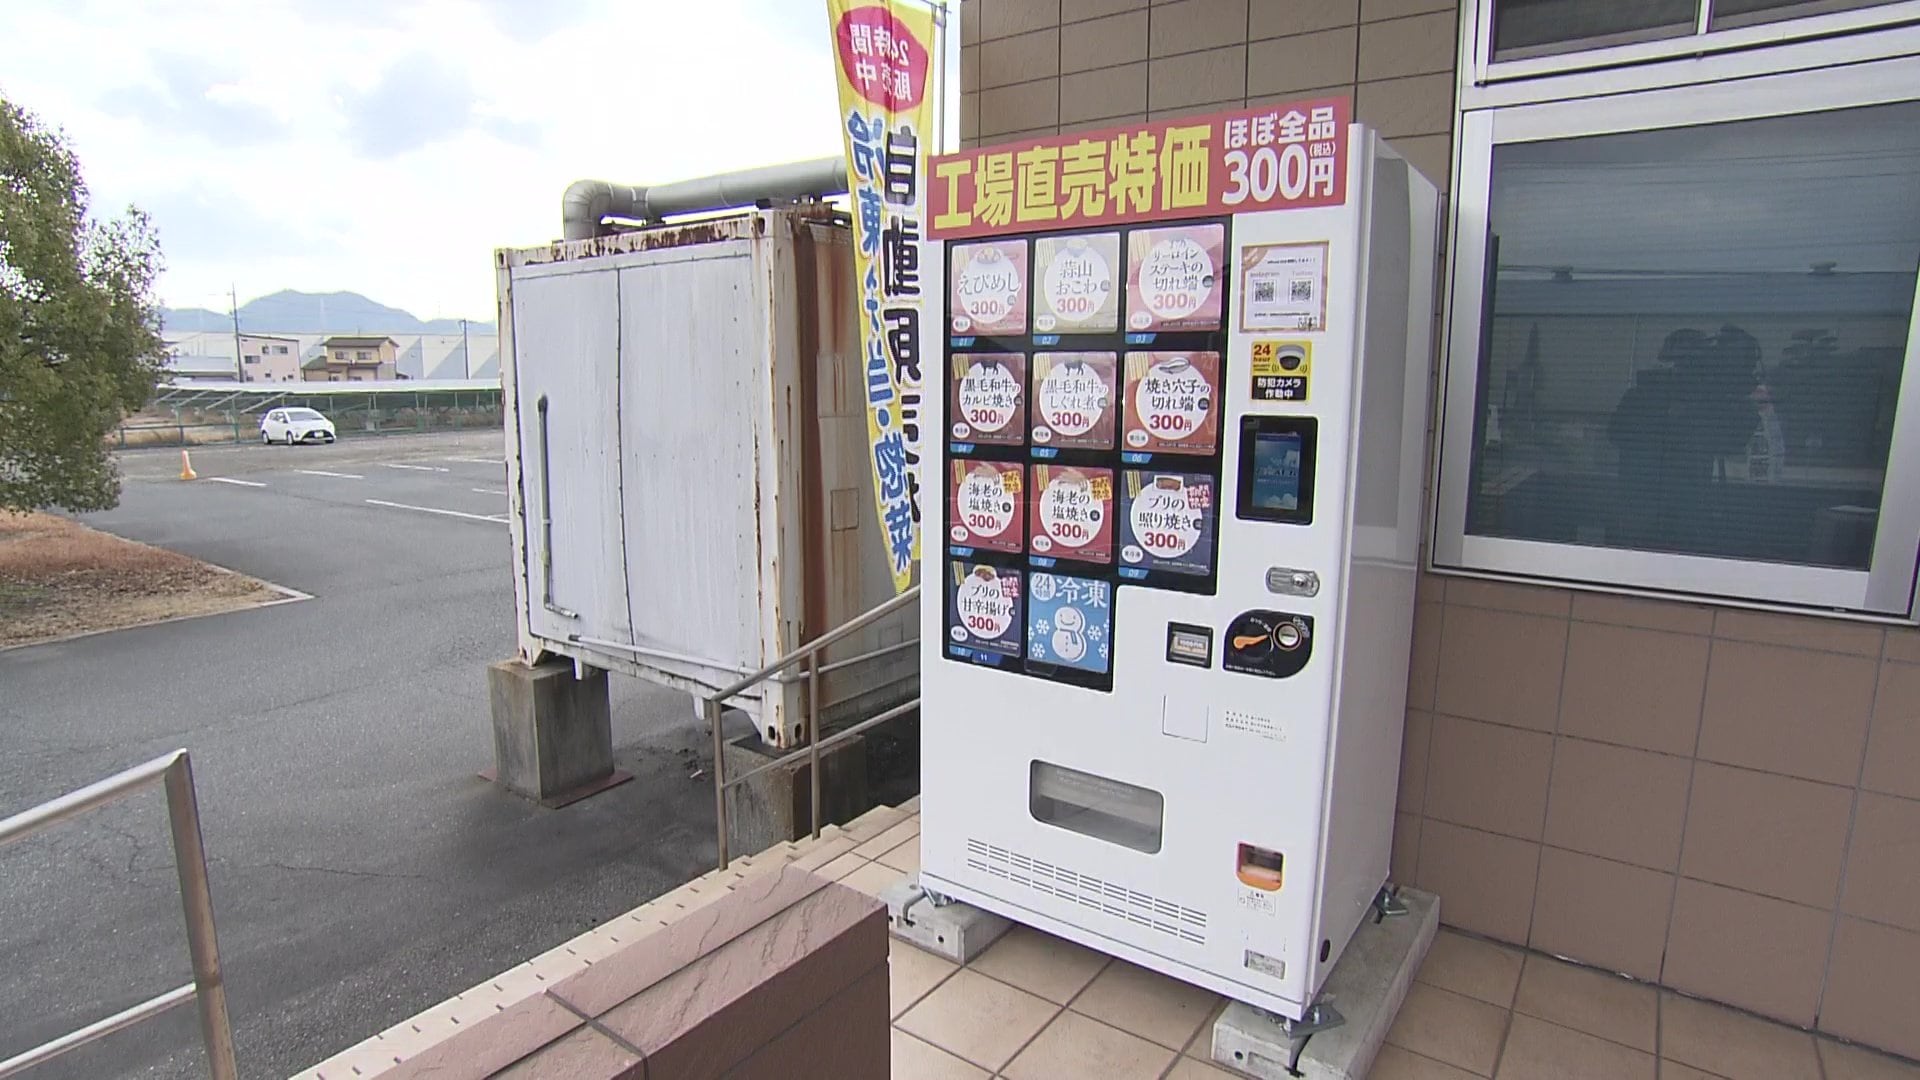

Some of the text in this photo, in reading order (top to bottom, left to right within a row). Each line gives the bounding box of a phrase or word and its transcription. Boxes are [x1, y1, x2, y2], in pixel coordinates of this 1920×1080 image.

[1224, 106, 1335, 149] ほぼ全品
[934, 124, 1211, 228] 工場直売特価
[1222, 144, 1335, 205] 300円
[1150, 261, 1203, 276] ステーキの
[959, 272, 1021, 295] えびめし
[1056, 279, 1098, 295] おこわ
[1154, 275, 1199, 292] 切れ端
[971, 301, 1005, 316] 300円
[1056, 298, 1095, 313] 300円
[1153, 293, 1197, 309] 300円
[1253, 344, 1271, 356] 24
[964, 378, 1021, 393] 黒毛和牛の
[1045, 378, 1108, 394] 黒毛和牛の
[1145, 378, 1209, 394] 焼き穴子の
[1257, 377, 1301, 389] 防犯カメラ
[962, 393, 1013, 409] カルビ焼き
[1265, 388, 1294, 400] 作動中
[1050, 394, 1097, 411] しぐれ煮
[1152, 395, 1195, 412] 切れ端
[970, 409, 1004, 424] 300円
[1051, 412, 1090, 428] 300円
[1149, 414, 1193, 431] 300円
[968, 482, 1003, 498] 海老の
[1052, 489, 1090, 506] 海老の
[968, 498, 1001, 514] 塩焼き
[1149, 495, 1185, 511] ブリの
[1052, 506, 1089, 522] 塩焼き
[1139, 512, 1191, 531] 照り焼き
[968, 514, 1002, 531] 300円
[1052, 523, 1089, 540] 300円
[1144, 533, 1186, 550] 300円
[1035, 574, 1051, 590] 24
[971, 585, 1000, 599] ブリの
[1056, 577, 1107, 608] 冷凍
[962, 598, 1010, 616] 甘辛揚げ
[968, 615, 1001, 633] 300円
